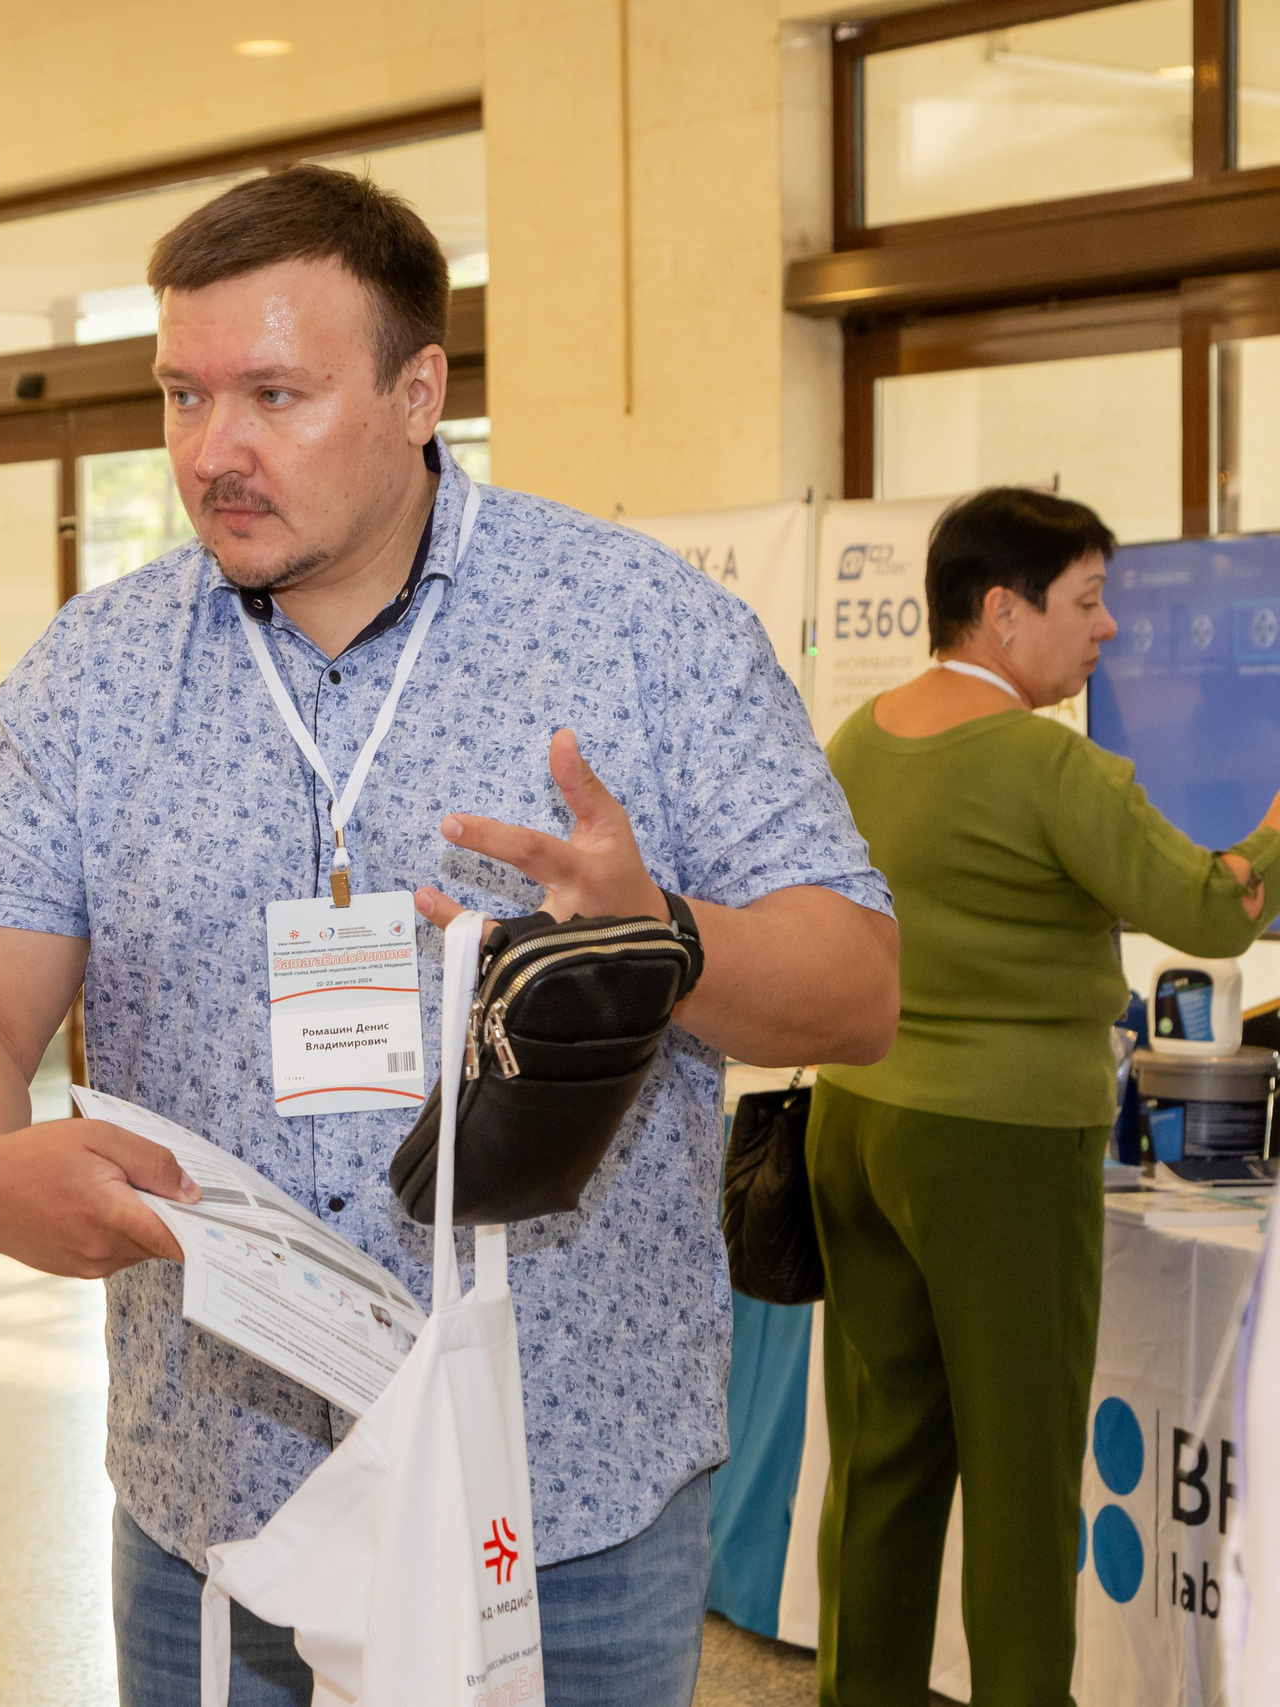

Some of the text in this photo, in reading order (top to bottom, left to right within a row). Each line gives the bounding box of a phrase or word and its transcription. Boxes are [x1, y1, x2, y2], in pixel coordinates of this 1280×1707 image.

[836, 597, 922, 639] E360
[291, 946, 326, 955] всероссийская
[327, 944, 378, 952] научно-практическая
[273, 948, 412, 970] SamaraEndoSummer
[329, 965, 366, 973] эндоскопистов
[302, 1022, 389, 1037] Ромашин Денис
[306, 1038, 387, 1051] Владимирович
